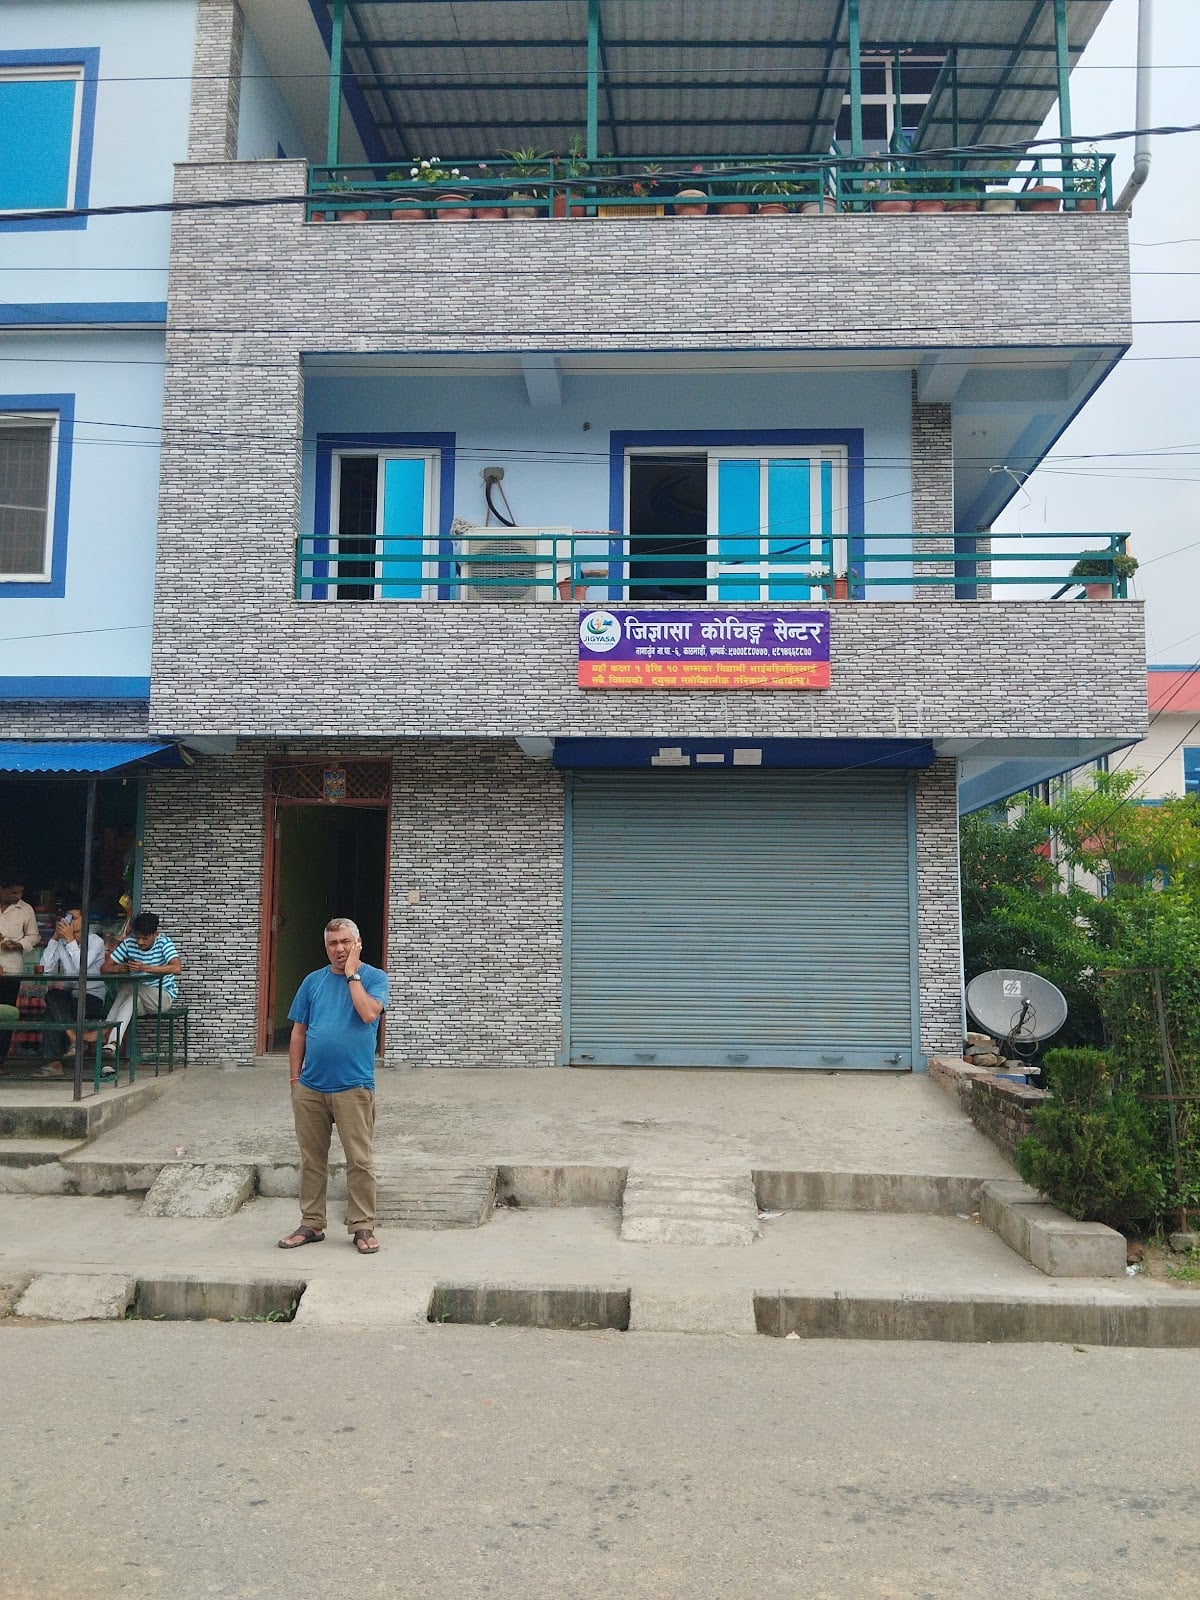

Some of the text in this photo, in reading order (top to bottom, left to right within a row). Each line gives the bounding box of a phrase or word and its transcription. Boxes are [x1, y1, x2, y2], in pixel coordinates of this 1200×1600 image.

[624, 616, 824, 644] जिज्ञासा कोचिङ्ग सेन्टर
[645, 663, 662, 673] देखि
